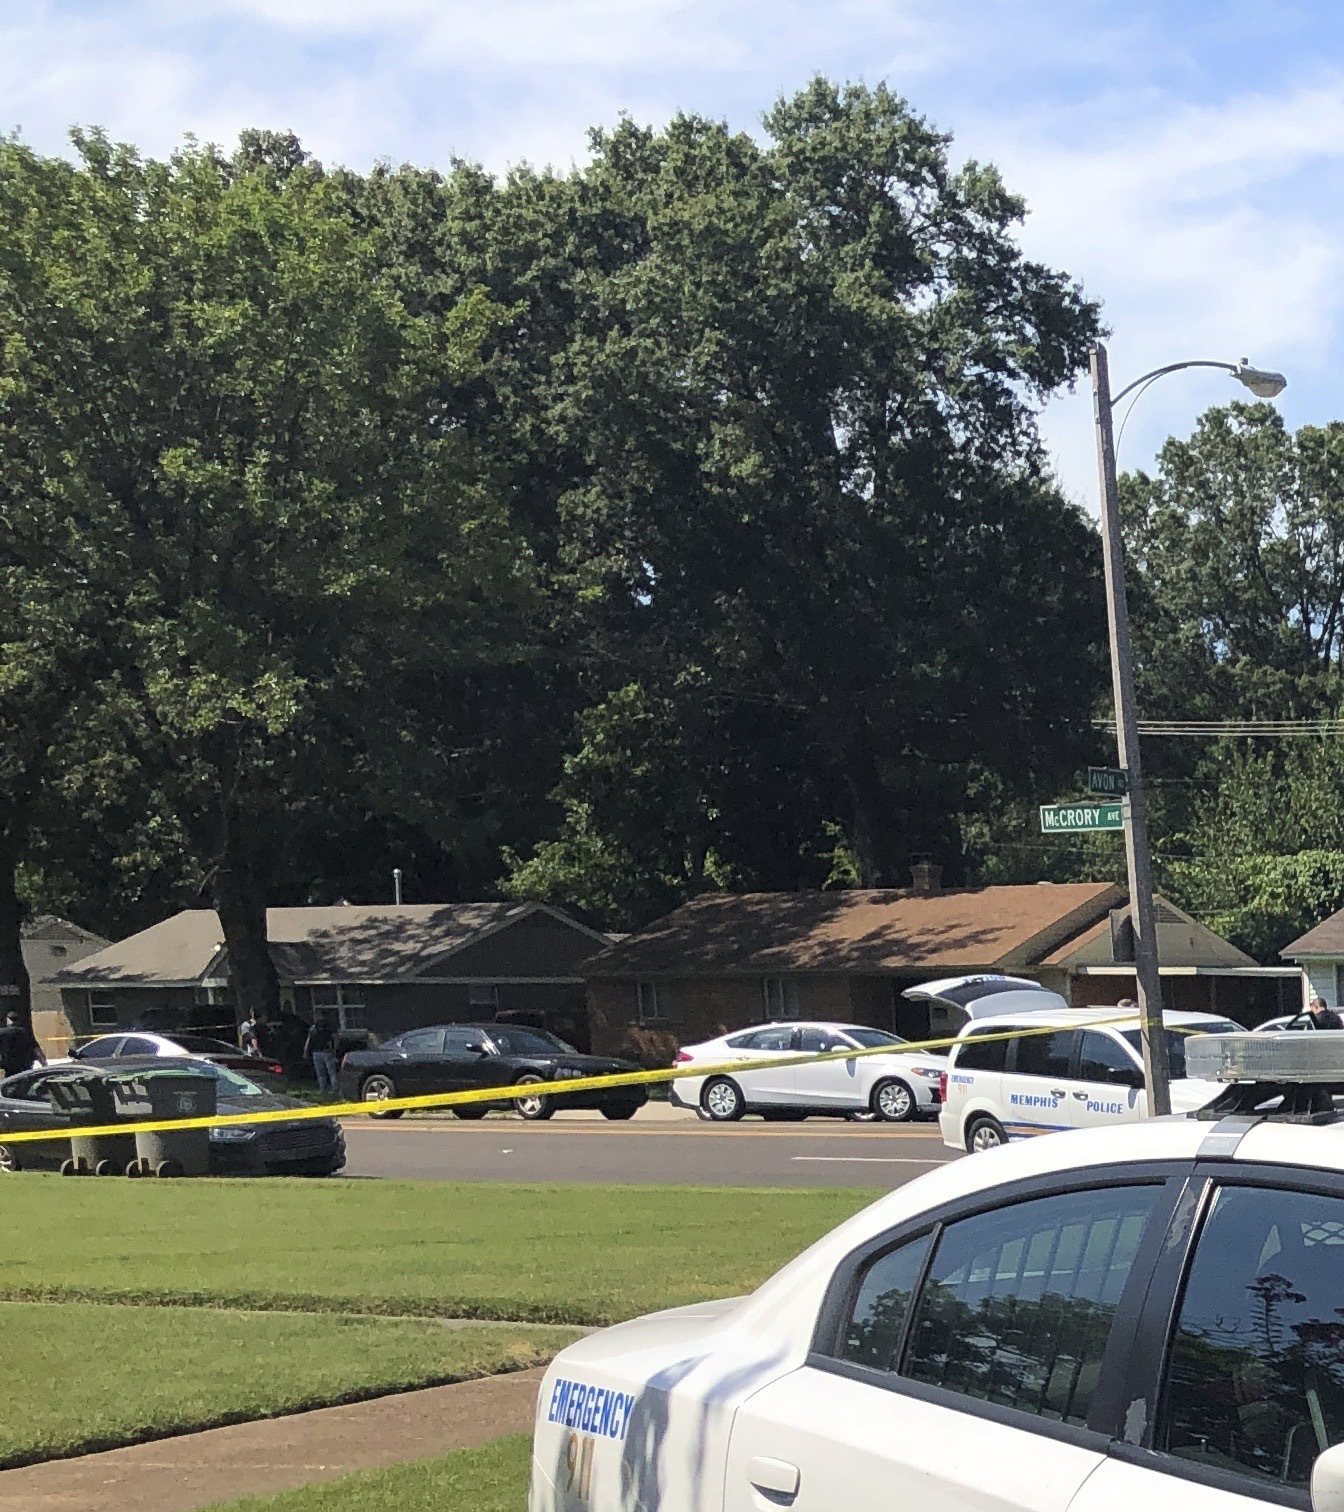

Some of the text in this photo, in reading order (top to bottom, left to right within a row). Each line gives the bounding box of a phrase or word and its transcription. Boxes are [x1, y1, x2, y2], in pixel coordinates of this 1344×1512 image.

[1091, 772, 1115, 791] AVON
[1044, 809, 1120, 827] McCRORY AVE
[1010, 1093, 1123, 1115] MEMPHIS POLICE
[548, 1378, 635, 1440] EMERGENCY
[566, 1432, 596, 1502] 911
